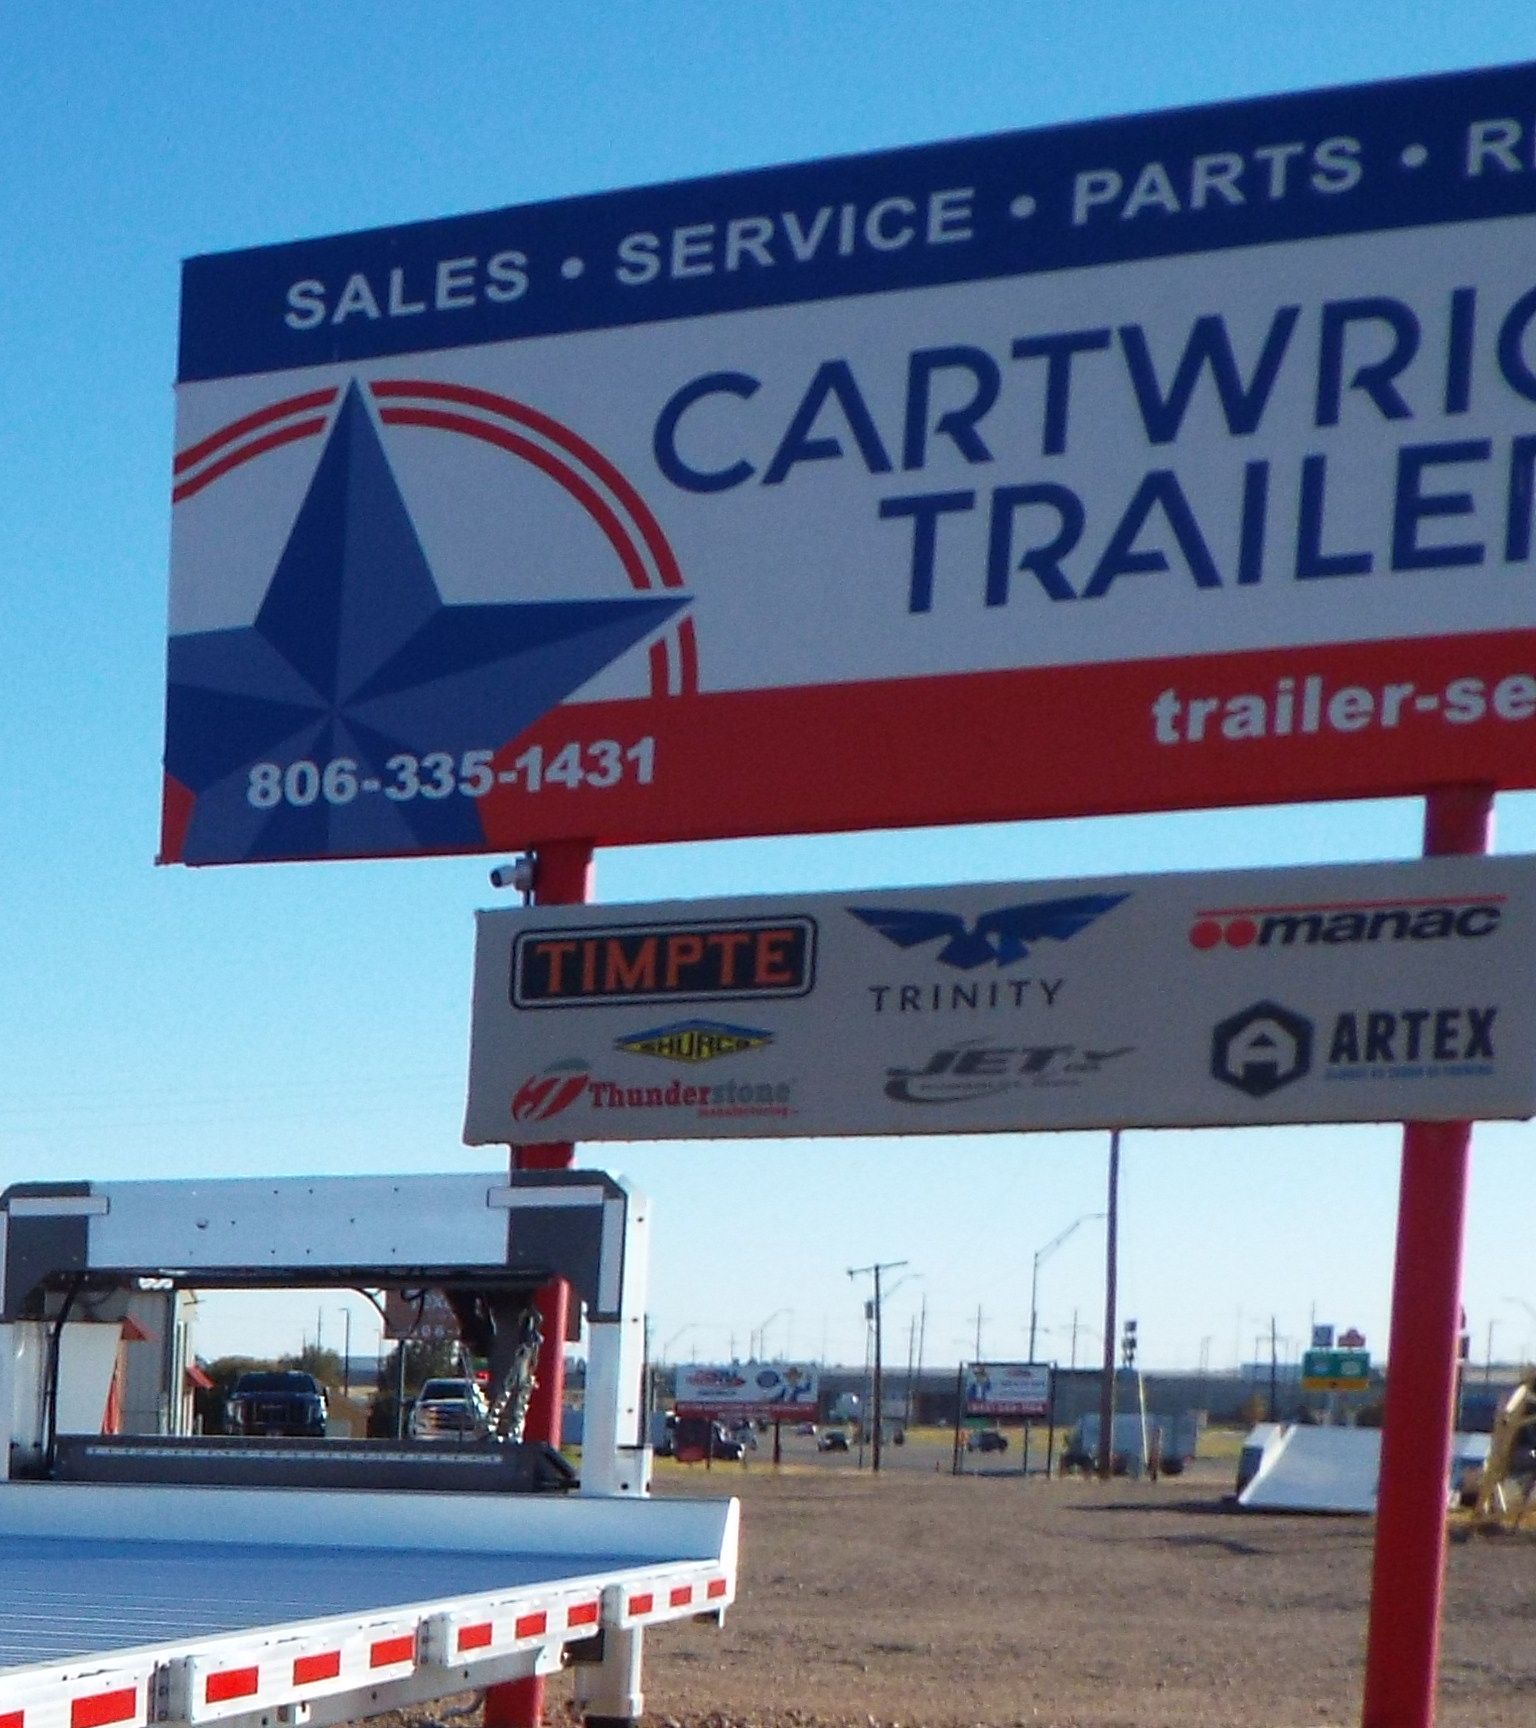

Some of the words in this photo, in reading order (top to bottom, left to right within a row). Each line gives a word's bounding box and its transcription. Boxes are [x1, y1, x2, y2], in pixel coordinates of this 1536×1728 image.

[283, 249, 529, 330] SALES
[616, 190, 976, 286] SERVICE
[1071, 136, 1363, 227] PARTS
[1467, 117, 1536, 177] R
[246, 735, 656, 809] 806-335-1431
[1257, 905, 1501, 948] manac
[536, 928, 796, 994] TIMPTE
[868, 978, 1064, 1013] TRINITY
[1328, 1004, 1497, 1064] ARTEX
